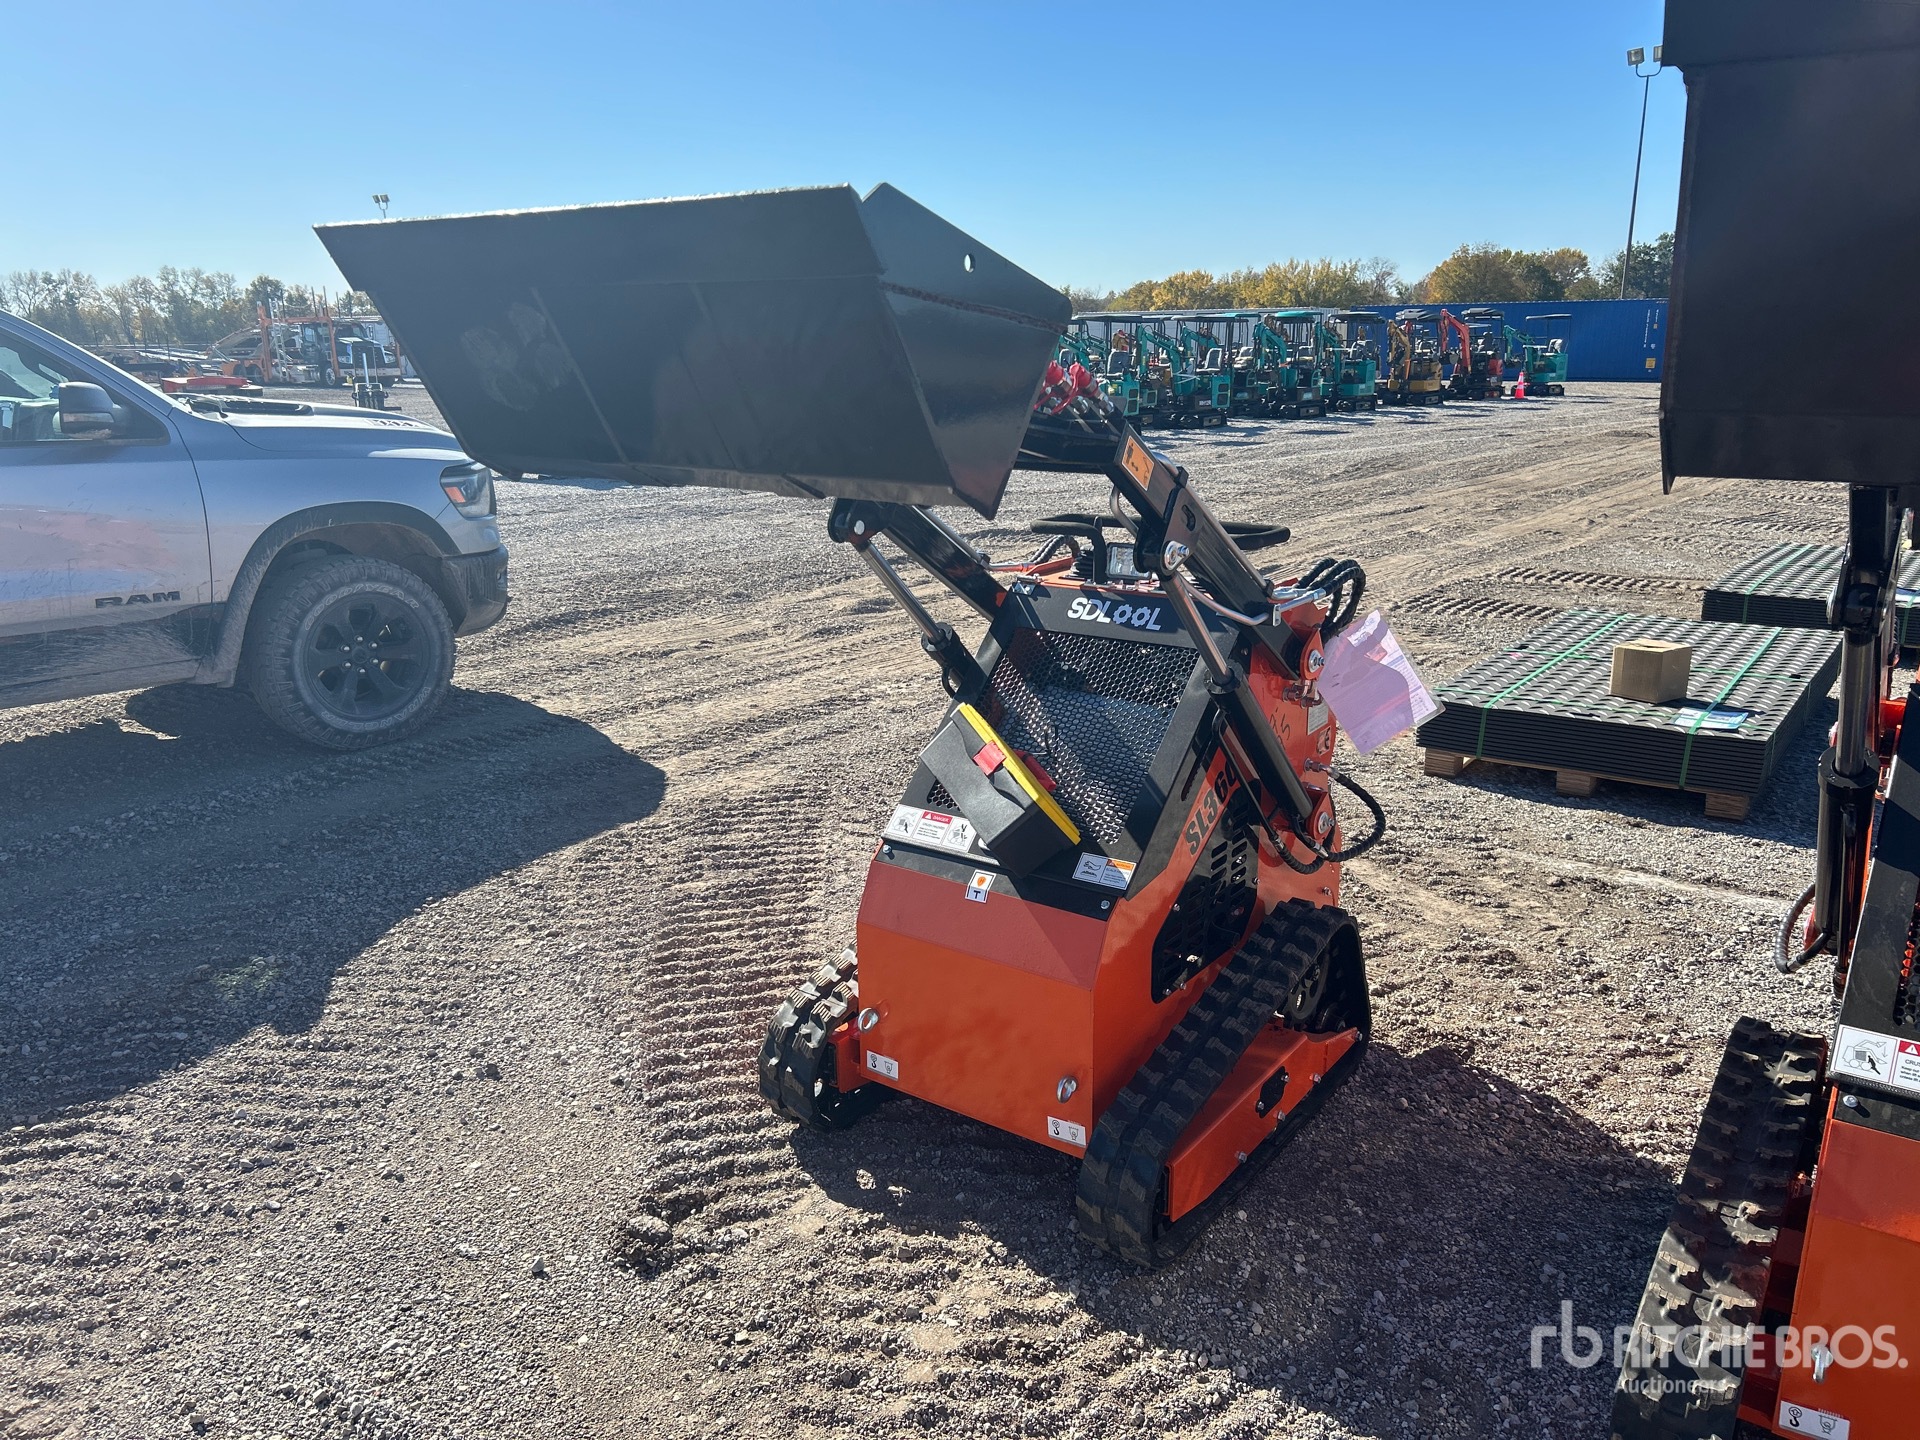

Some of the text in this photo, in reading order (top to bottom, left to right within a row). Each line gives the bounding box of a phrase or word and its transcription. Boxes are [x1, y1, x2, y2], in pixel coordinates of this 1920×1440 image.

[94, 590, 181, 609] RAM
[304, 583, 420, 631] GOODYEAR
[974, 890, 981, 899] T
